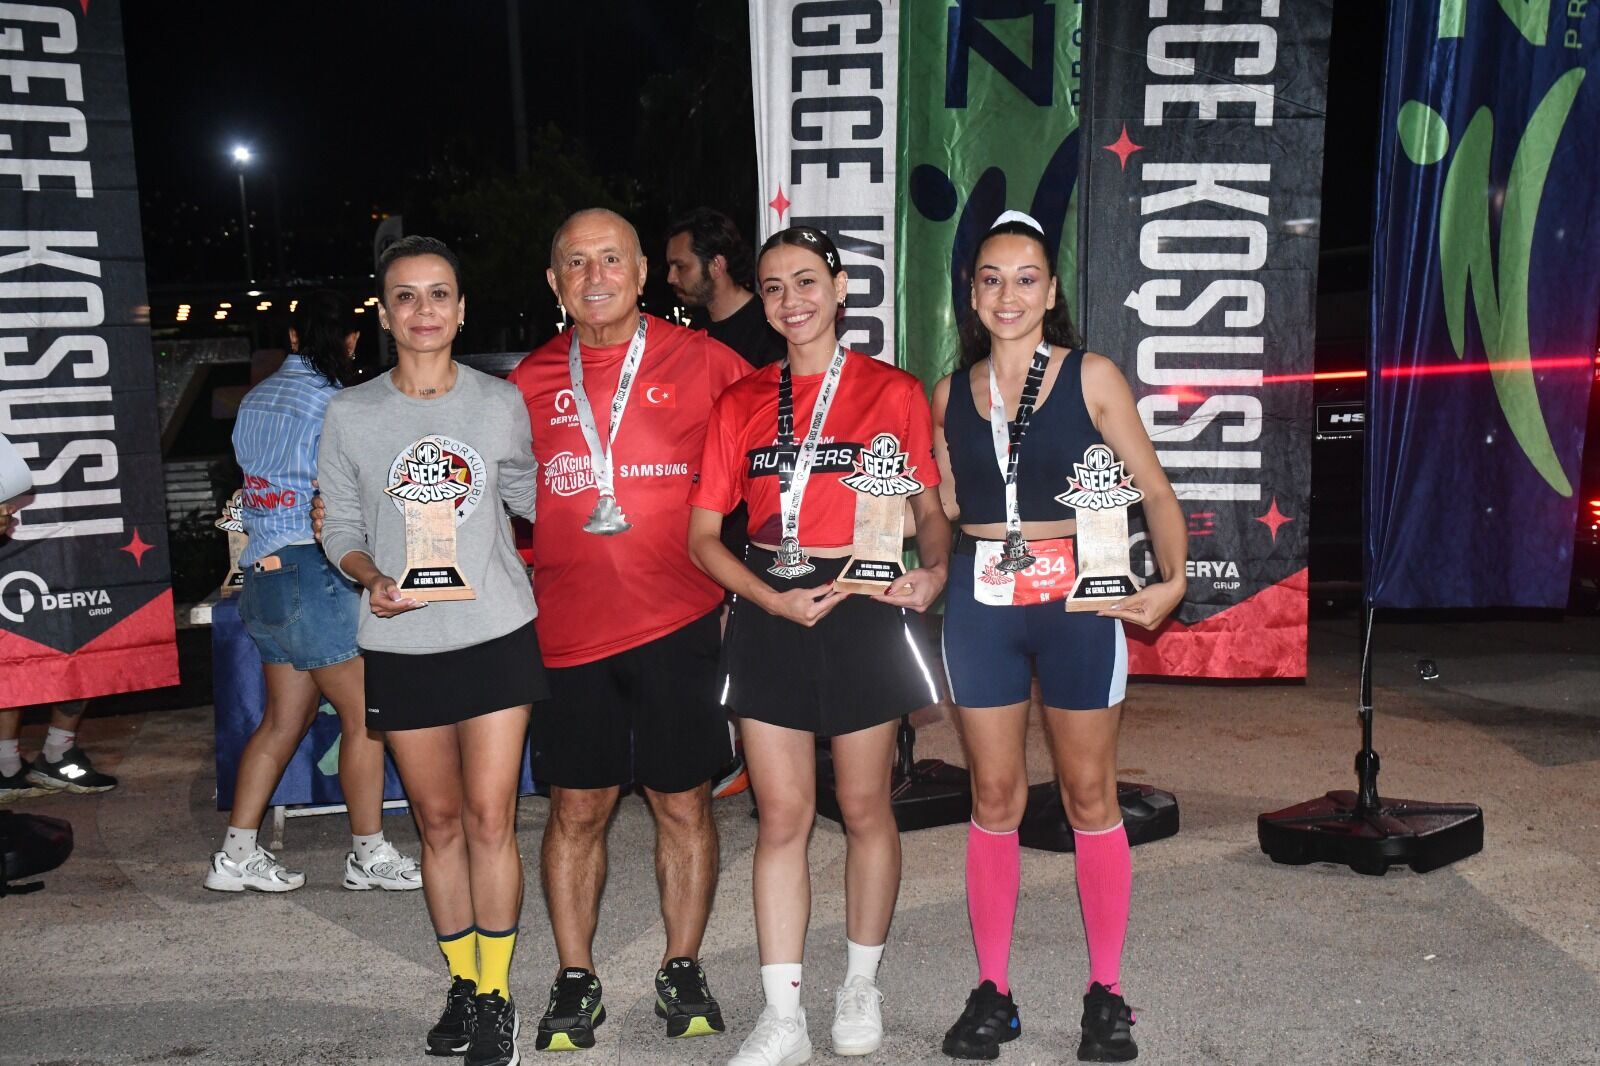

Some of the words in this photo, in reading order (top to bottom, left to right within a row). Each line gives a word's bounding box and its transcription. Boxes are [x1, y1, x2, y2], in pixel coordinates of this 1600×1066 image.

[0, 2, 94, 198] GECE
[790, 0, 884, 185] GECE
[1123, 163, 1271, 502] KOŞUSU
[550, 414, 580, 426] DERYA
[418, 445, 438, 463] MG
[875, 438, 895, 458] MG
[753, 449, 852, 470] RUERS
[863, 453, 904, 478] GECE
[1089, 450, 1110, 470] MG
[407, 460, 449, 485] GECE
[620, 463, 688, 478] SAMSUNG
[1079, 466, 1120, 491] GECE
[1186, 561, 1240, 578] ERYA
[1213, 581, 1241, 590] GRUP
[41, 590, 111, 611] DERYA
[88, 607, 113, 617] GRUP
